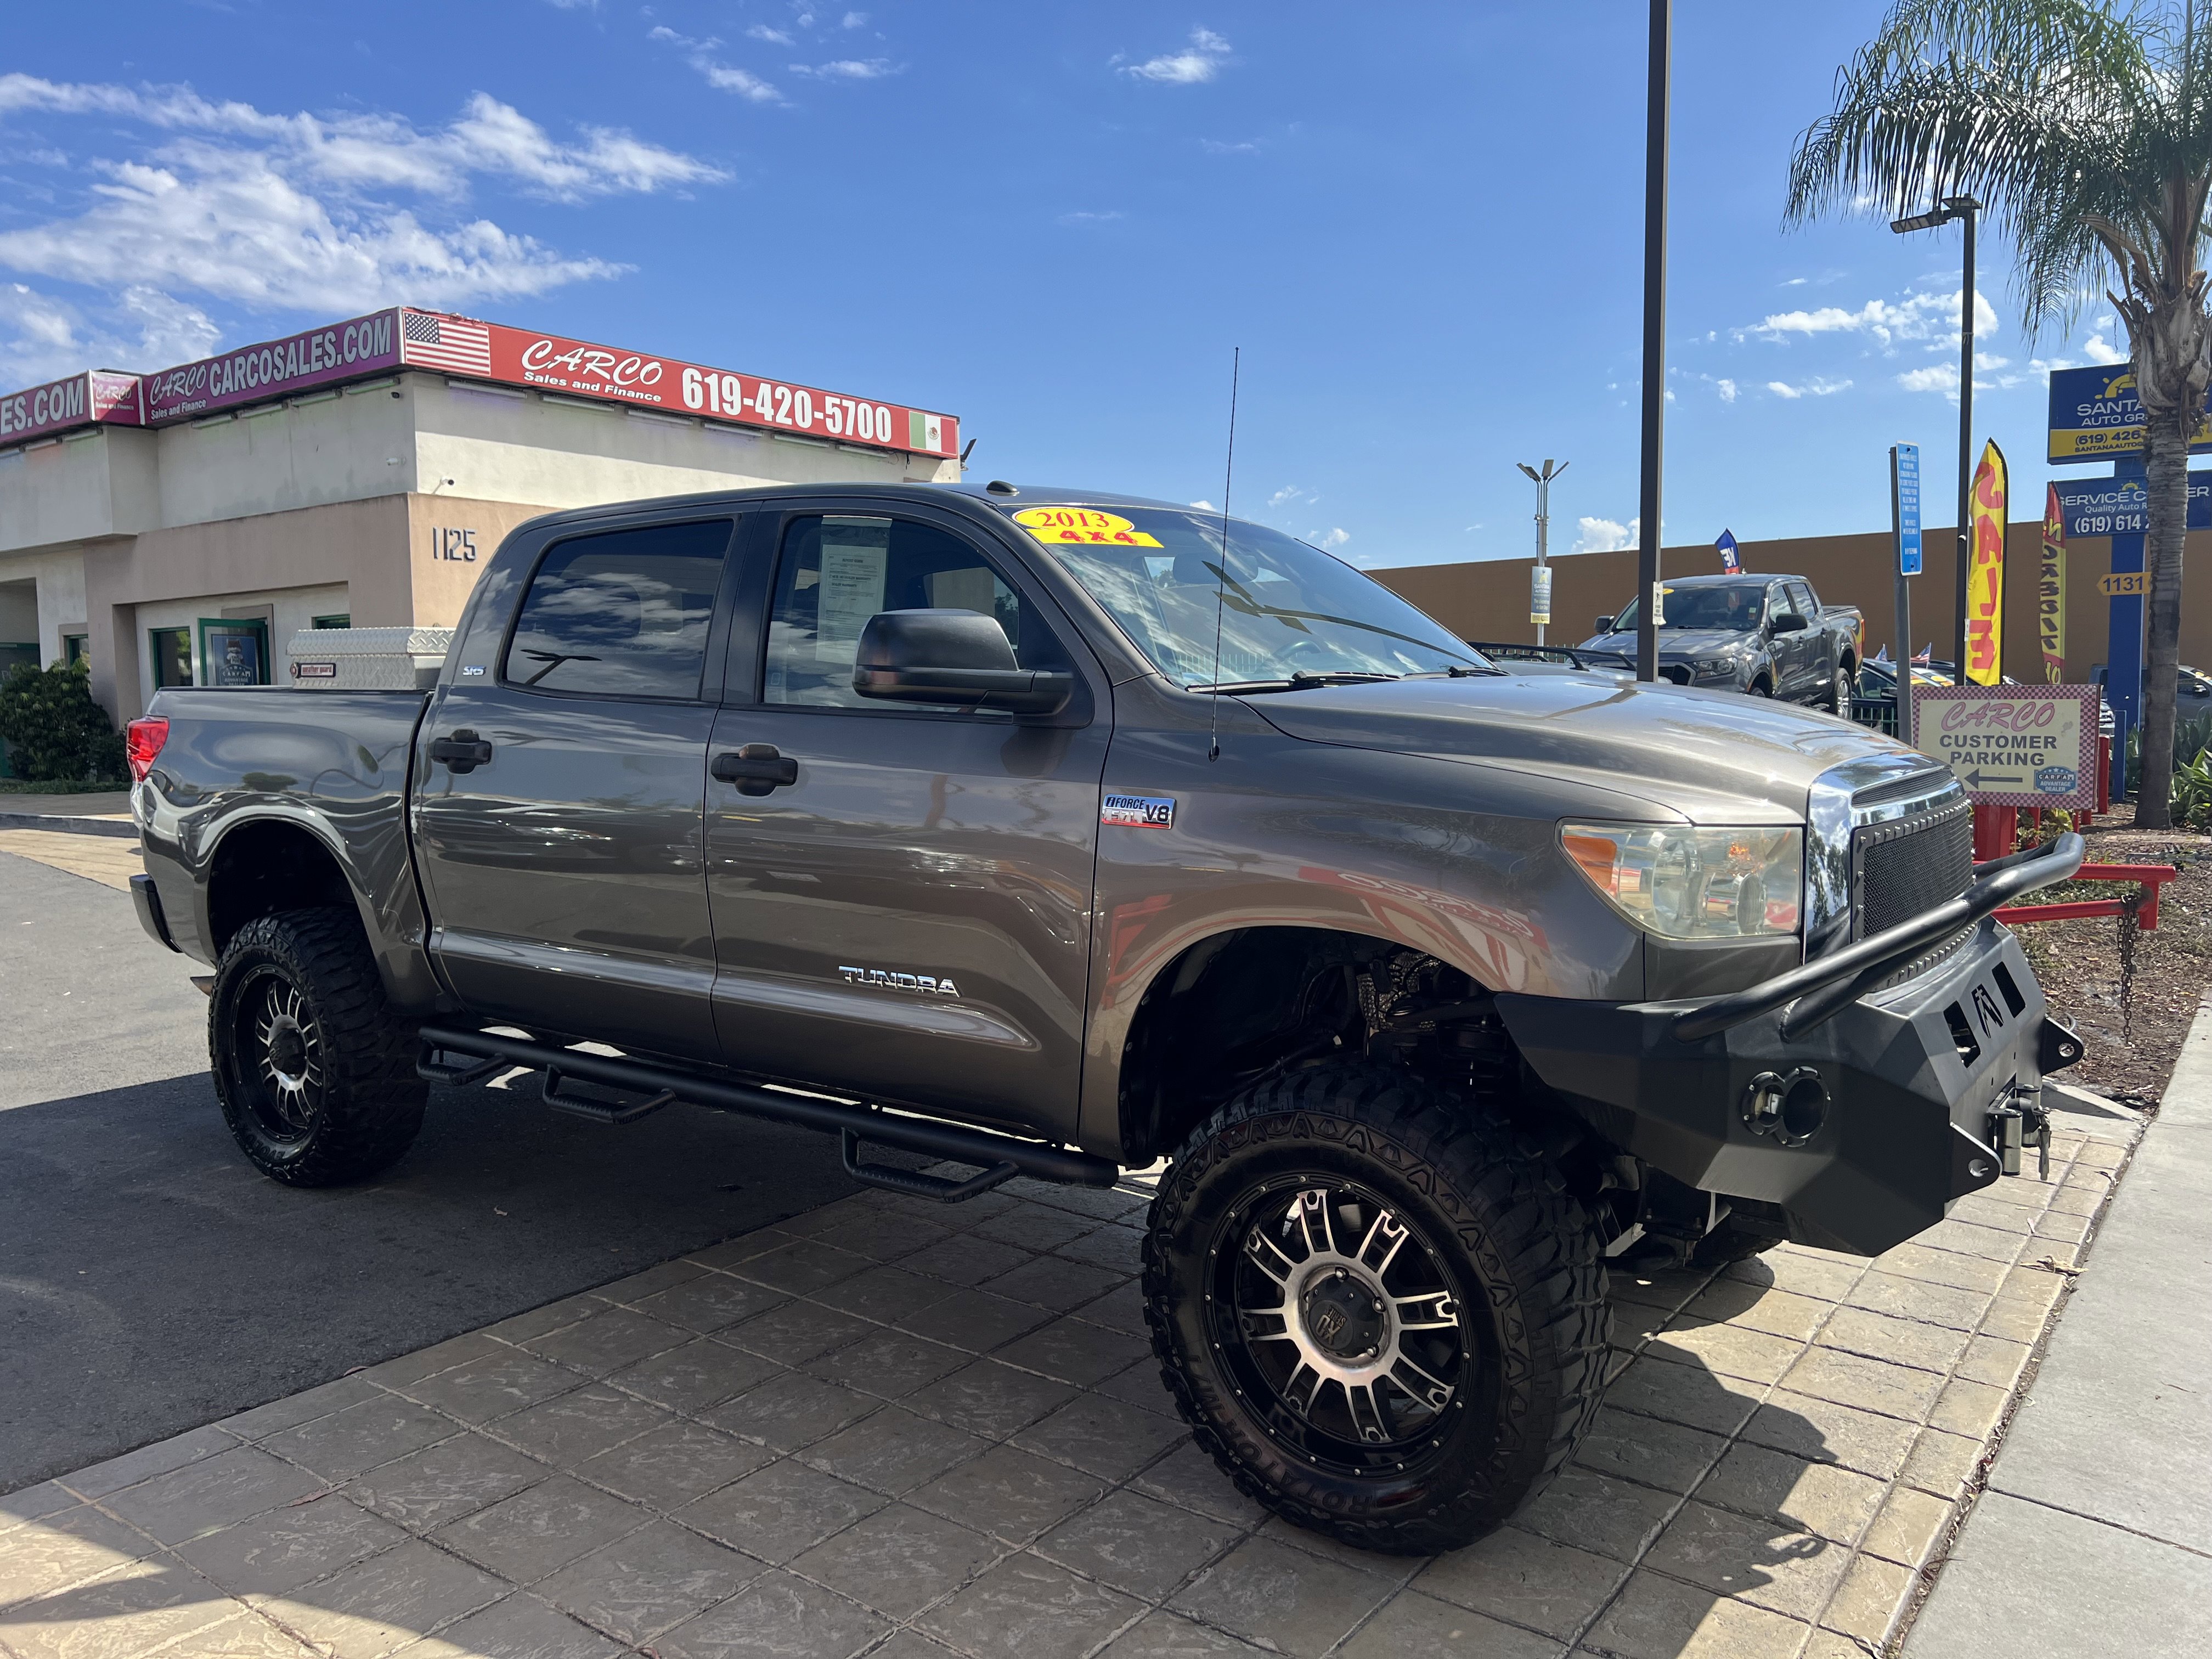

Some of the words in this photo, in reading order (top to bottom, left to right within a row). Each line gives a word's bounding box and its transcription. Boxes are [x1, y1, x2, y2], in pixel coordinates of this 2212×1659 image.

[209, 315, 392, 398] CARCOSALES.COM
[521, 340, 662, 385] CARCO
[150, 363, 206, 405] CARCO
[524, 371, 567, 387] Sales
[572, 380, 600, 392] and
[605, 385, 662, 402] Finance
[1, 377, 84, 435] ES.COM
[151, 409, 167, 420] Sales
[169, 407, 180, 415] and
[182, 399, 206, 413] Finance
[682, 367, 891, 443] 619-420-5700
[2081, 415, 2121, 426] AUTO
[2125, 413, 2148, 423] GR
[2075, 433, 2107, 446] (619)
[2111, 430, 2141, 441] 426
[2085, 504, 2116, 514] Quality
[1036, 512, 1109, 528] 2013
[2075, 516, 2111, 534] (619)
[2115, 514, 2142, 531] 614
[433, 526, 477, 562] 1125
[2103, 576, 2143, 592] 1131
[1941, 702, 2056, 732] CARCO
[1939, 735, 2058, 749] CUSTOMER
[1950, 752, 2045, 767] PARKING
[1146, 804, 1170, 823] V8
[838, 965, 961, 998] TUNDRA
